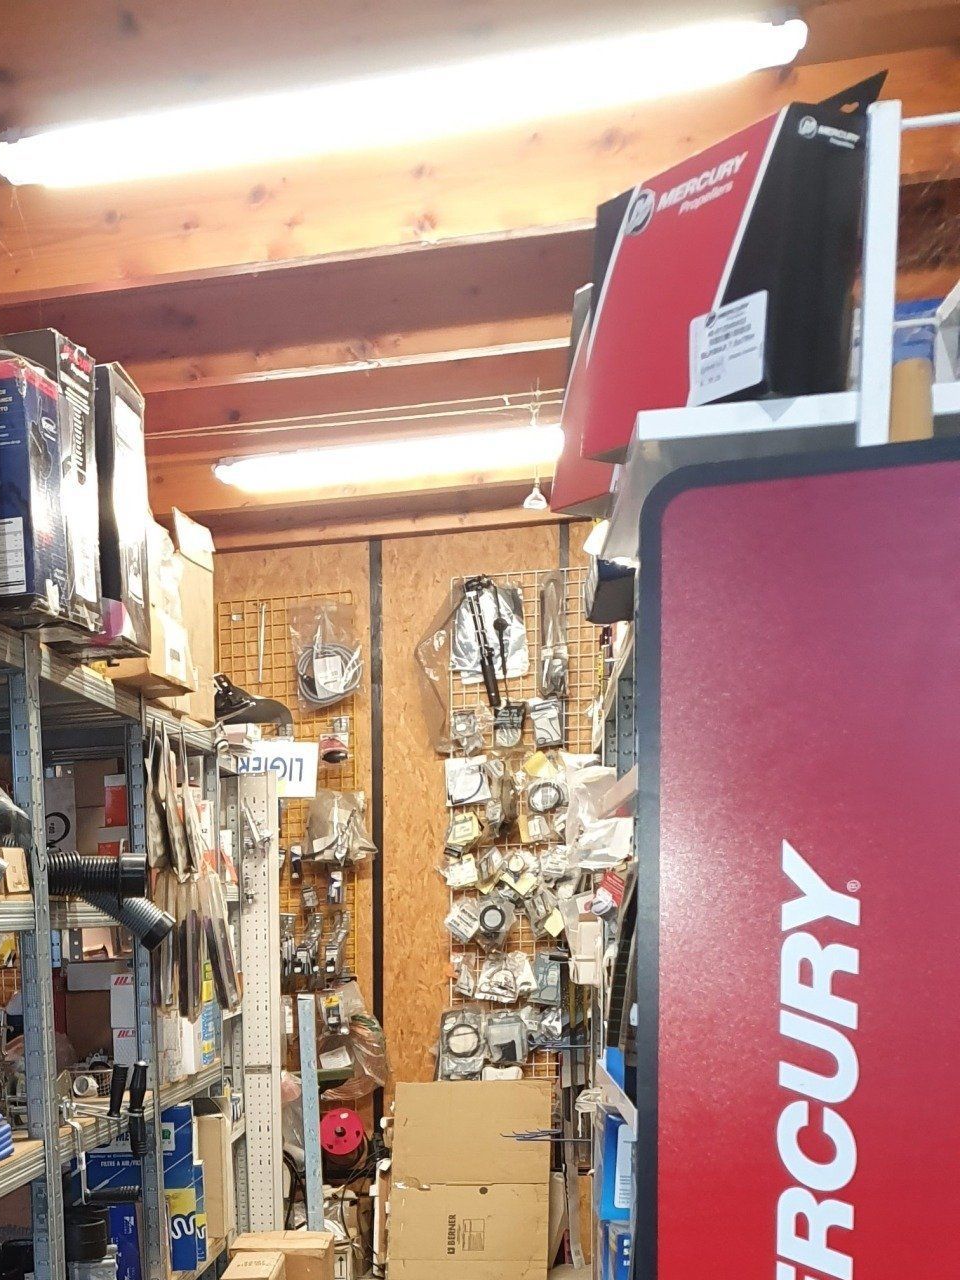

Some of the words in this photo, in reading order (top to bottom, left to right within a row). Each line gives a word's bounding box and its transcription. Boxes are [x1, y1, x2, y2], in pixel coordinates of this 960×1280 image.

[657, 150, 749, 212] MERCURY
[678, 180, 734, 215] Propellers
[447, 1214, 456, 1246] BERNER
